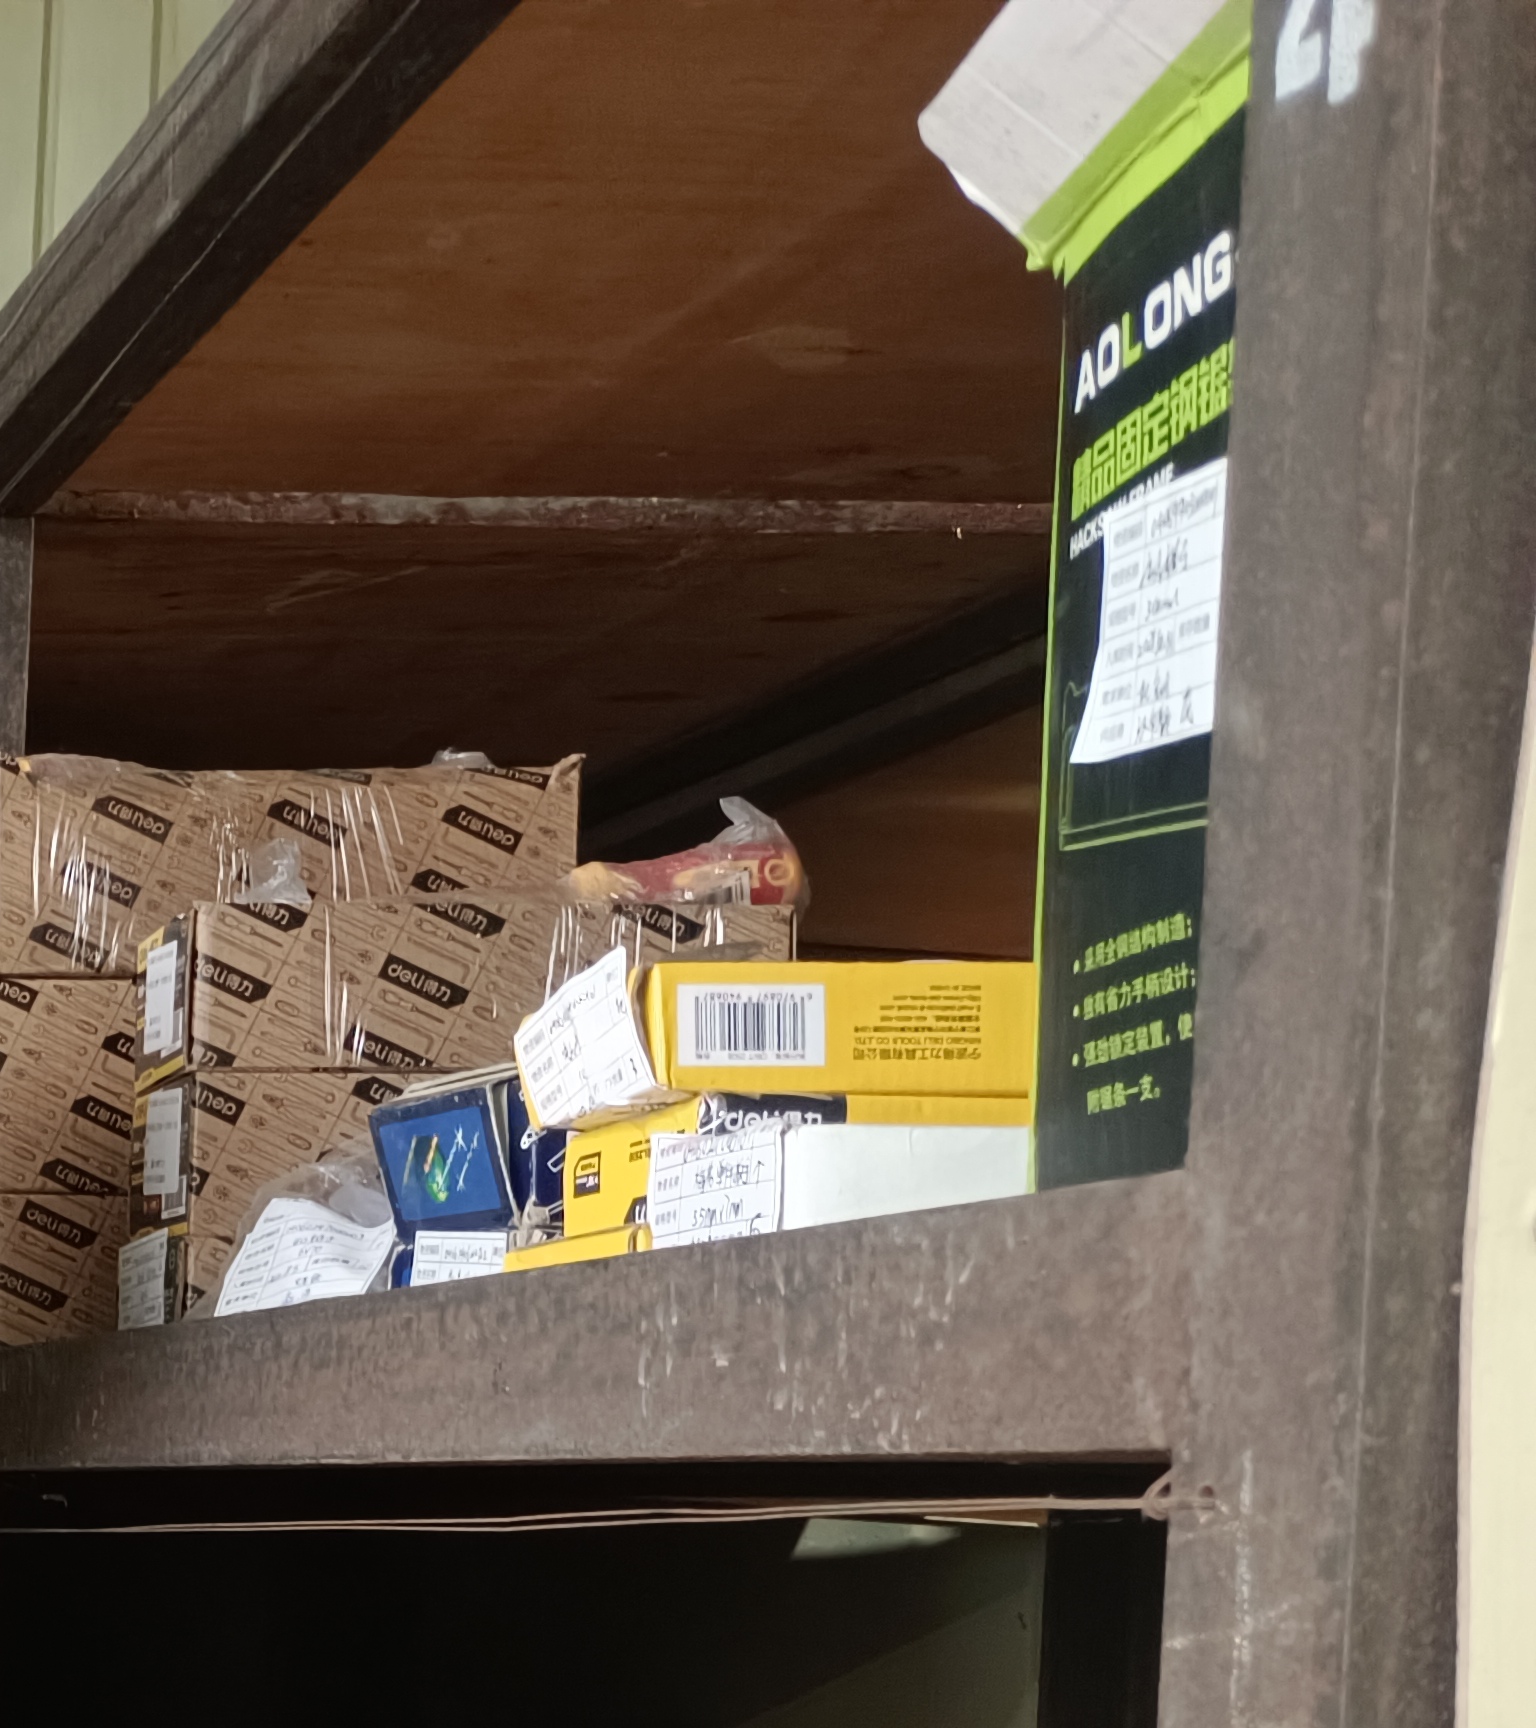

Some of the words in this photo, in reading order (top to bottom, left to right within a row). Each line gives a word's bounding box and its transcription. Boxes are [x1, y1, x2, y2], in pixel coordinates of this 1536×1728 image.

[1074, 230, 1232, 414] AOLONG
[1071, 338, 1235, 520] 精品固定钢锯
[458, 810, 515, 846] deli得力
[387, 960, 452, 1002] deli得力
[85, 1100, 133, 1132] eli得力
[26, 1205, 82, 1243] deli得力
